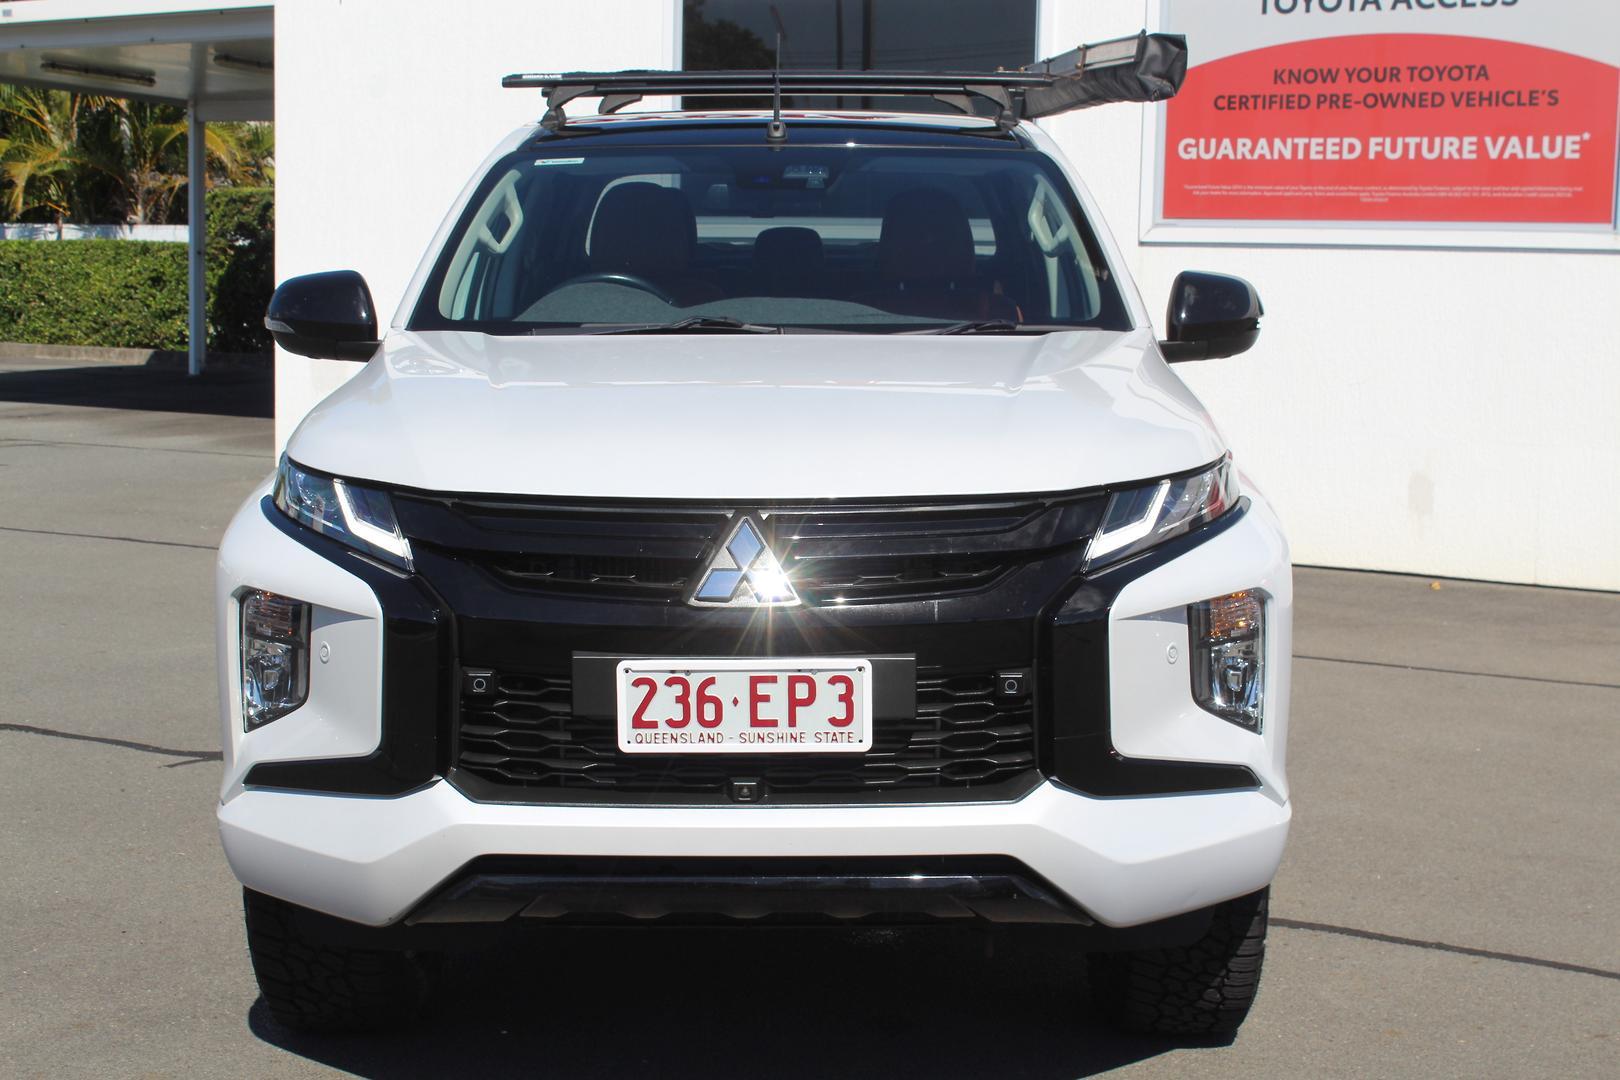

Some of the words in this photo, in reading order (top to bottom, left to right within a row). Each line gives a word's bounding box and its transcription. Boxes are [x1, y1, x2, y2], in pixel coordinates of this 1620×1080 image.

[1273, 68, 1340, 84] KNOW
[1344, 66, 1401, 84] YOUR
[1406, 65, 1489, 82] TOYOTA
[1213, 94, 1311, 111] CERTIFIED
[1316, 91, 1445, 109] PRE-OWNED
[1450, 89, 1559, 107] VEHICLE'S
[1177, 137, 1362, 160] GUARANTEED
[1368, 136, 1478, 160] FUTURE
[749, 675, 855, 728] EP3
[635, 731, 724, 744] QUEENSLAND
[739, 731, 806, 744] SUNSHINE
[814, 731, 854, 744] STATE
